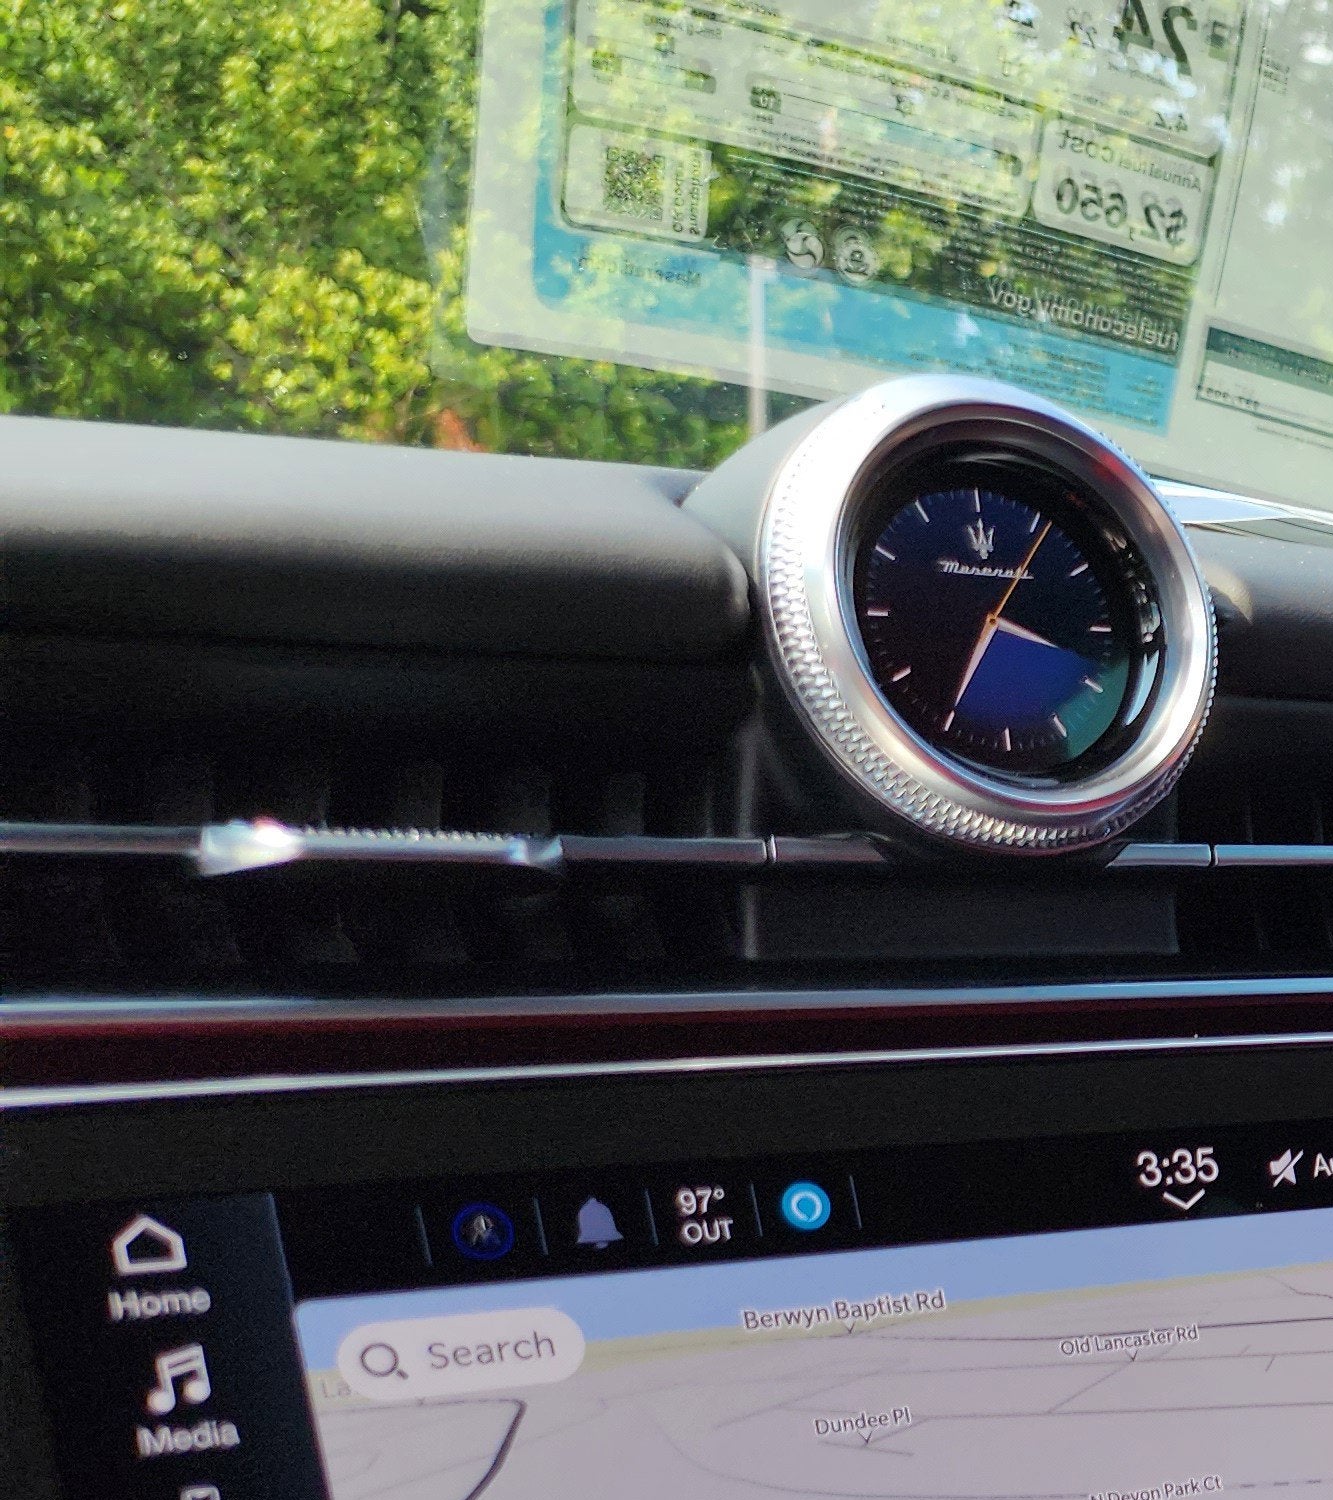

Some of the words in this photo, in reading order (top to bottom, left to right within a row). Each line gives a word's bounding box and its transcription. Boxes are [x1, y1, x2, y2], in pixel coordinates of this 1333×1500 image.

[1137, 1147, 1220, 1188] 3:35
[682, 1219, 734, 1245] OUT
[108, 1287, 211, 1321] Home
[743, 1304, 829, 1330] Berwyn
[835, 1296, 912, 1322] Baptist
[916, 1289, 945, 1312] Rd
[428, 1331, 555, 1370] Search
[1060, 1335, 1093, 1357] Old
[1096, 1329, 1173, 1352] Lancaster
[1176, 1325, 1199, 1342] Rd
[815, 1411, 888, 1435] Dundee
[892, 1406, 911, 1427] Pl
[136, 1420, 240, 1459] Media
[1164, 1478, 1201, 1498] Park
[1203, 1475, 1223, 1491] Ct
